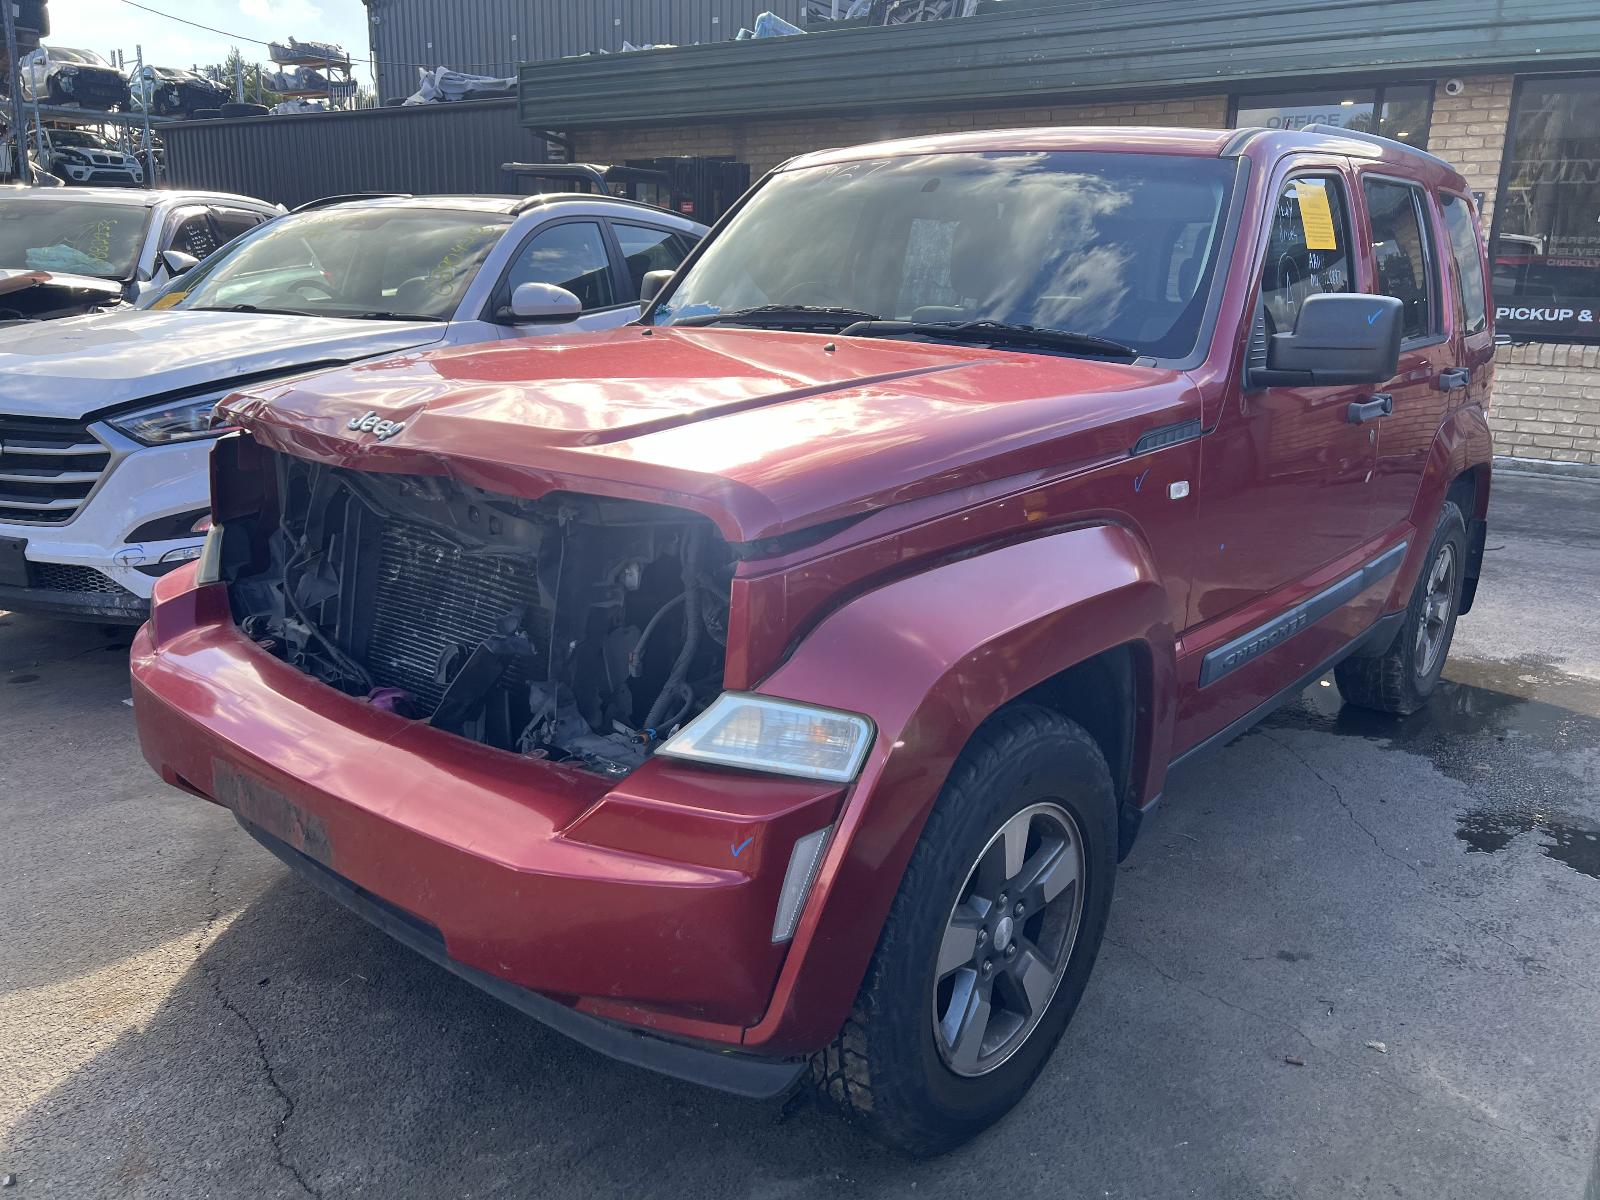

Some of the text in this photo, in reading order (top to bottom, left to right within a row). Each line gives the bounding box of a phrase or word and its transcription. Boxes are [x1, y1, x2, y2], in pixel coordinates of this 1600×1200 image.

[1266, 114, 1340, 129] OFFICE
[1495, 307, 1593, 322] PICKUP &
[347, 410, 406, 441] Jeep
